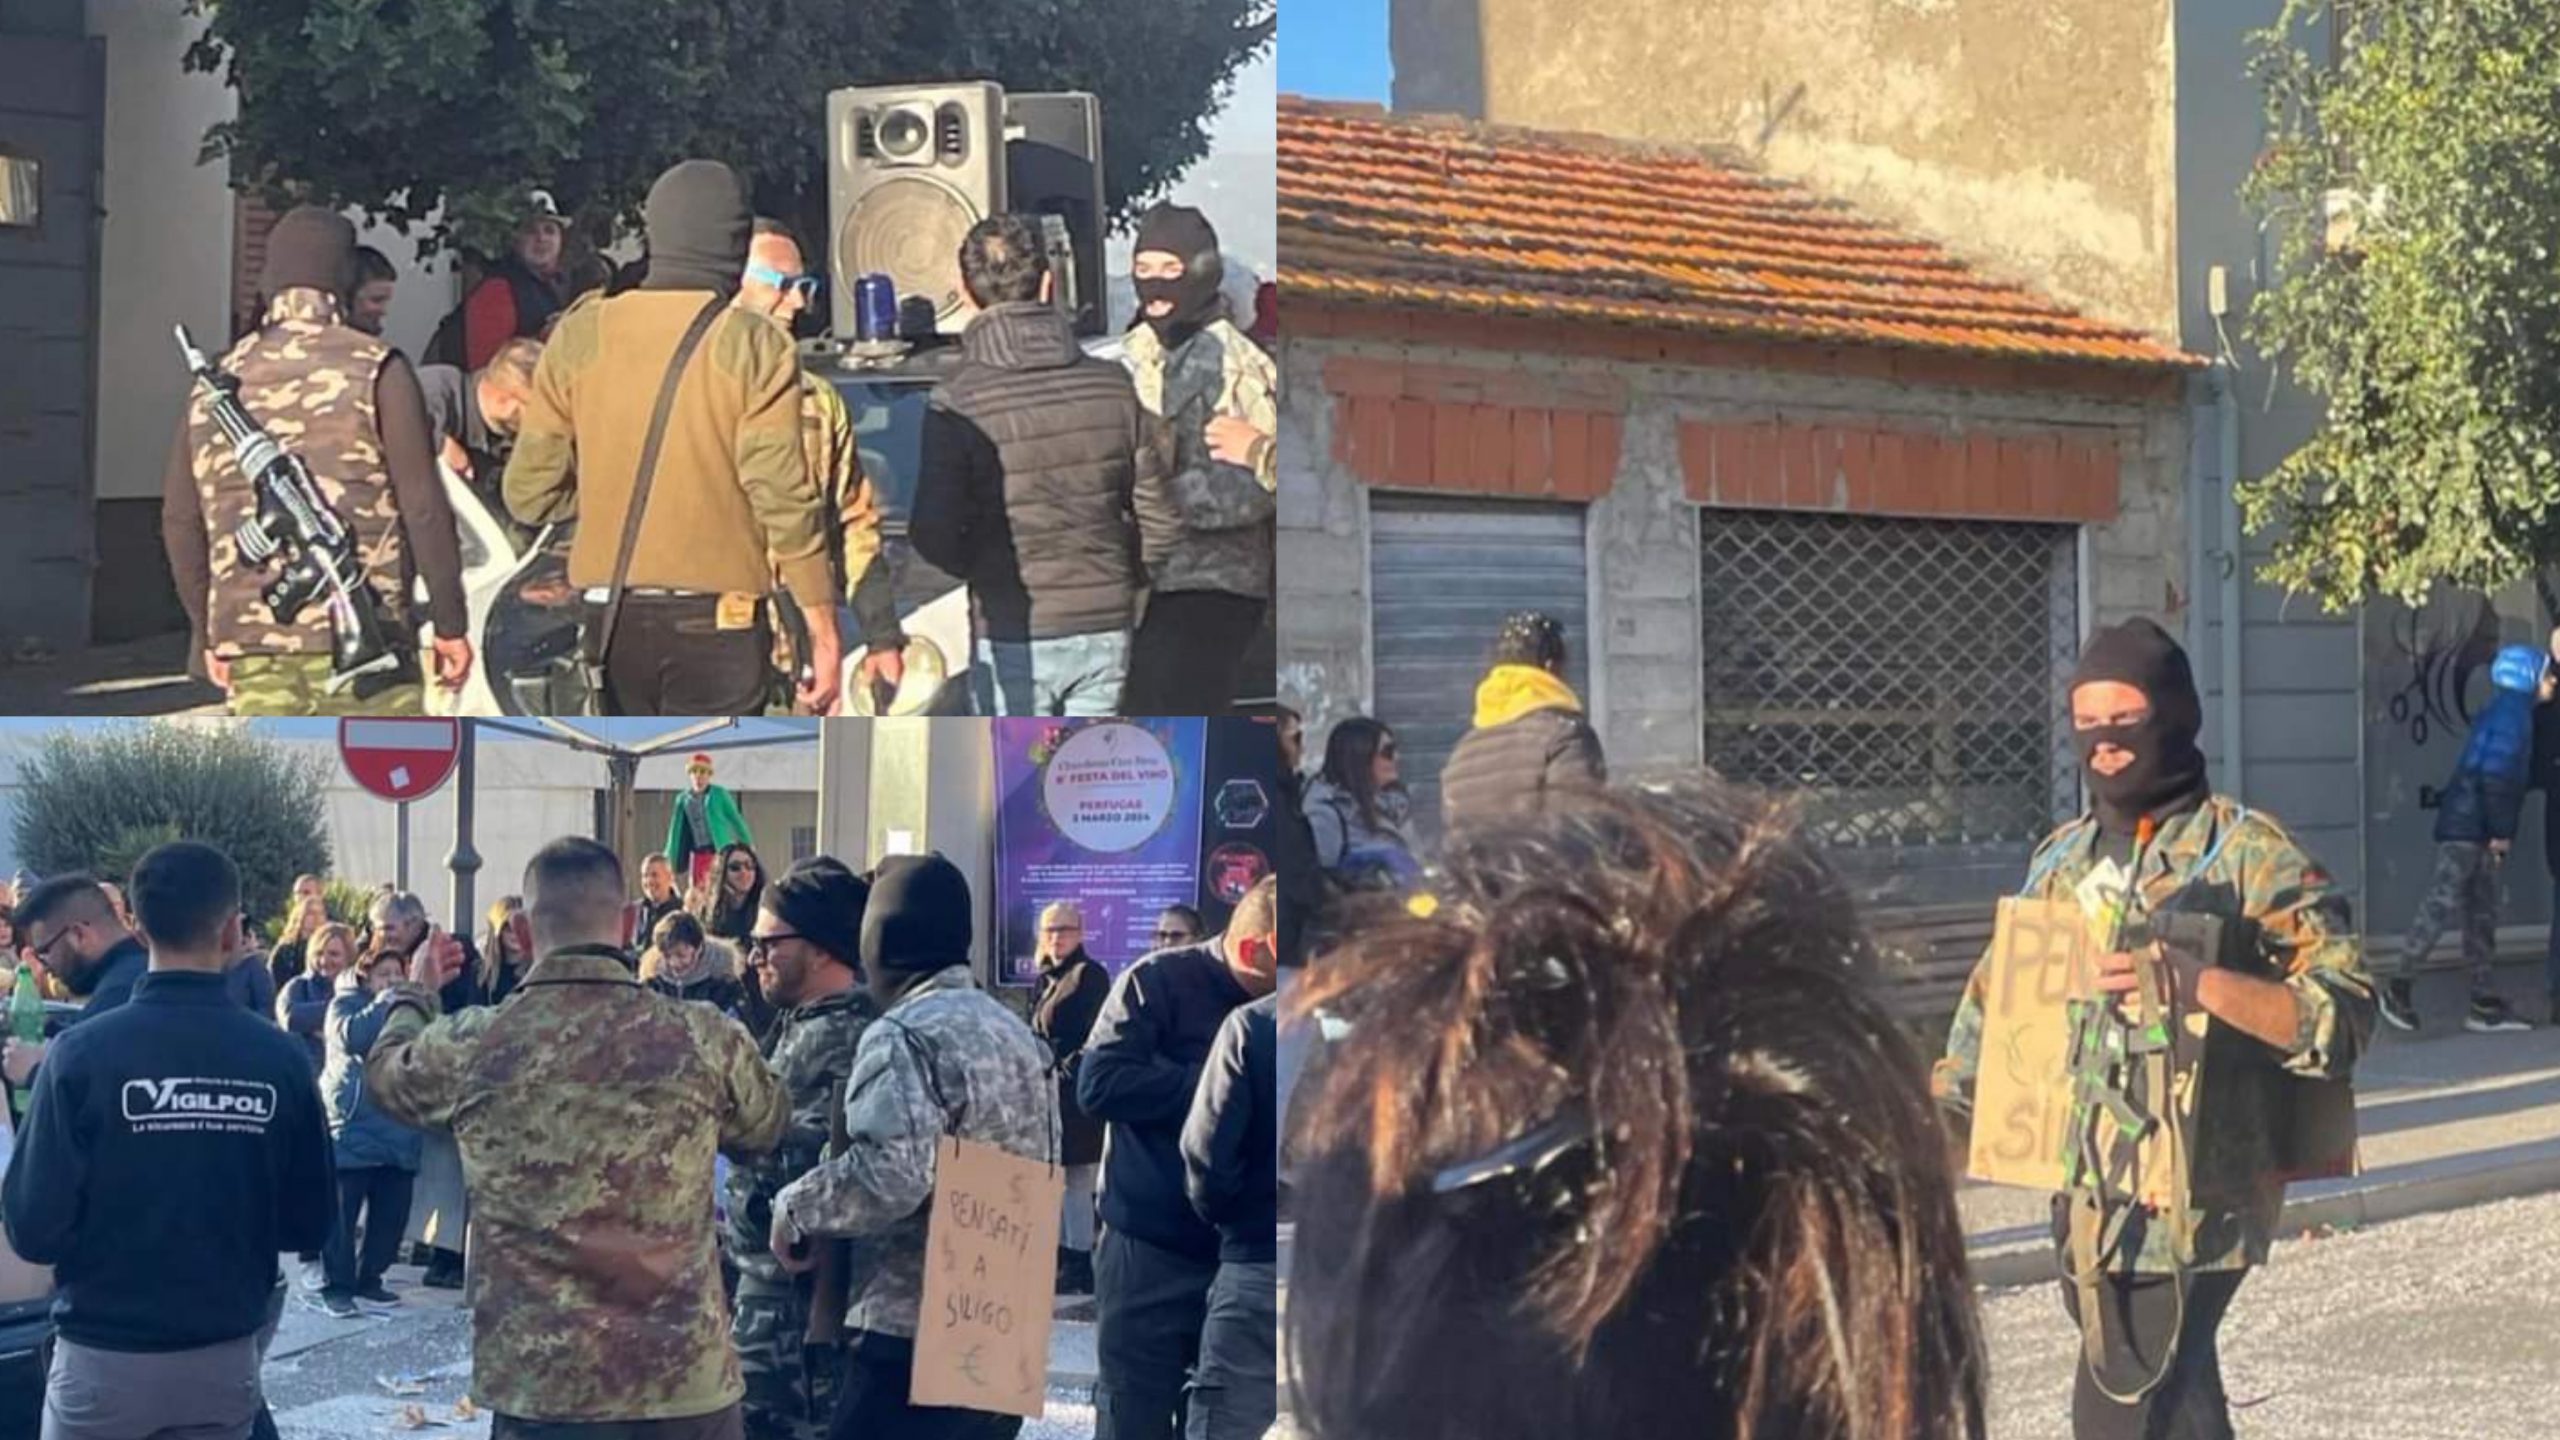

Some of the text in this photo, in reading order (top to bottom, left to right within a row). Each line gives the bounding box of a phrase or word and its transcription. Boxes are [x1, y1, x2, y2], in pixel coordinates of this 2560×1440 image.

[1070, 771, 1108, 783] FESTA
[1111, 770, 1133, 781] DEL
[1137, 769, 1168, 779] VINO
[1080, 799, 1142, 810] PERFUGAS
[1081, 812, 1121, 823] MARZO
[140, 1077, 268, 1115] VIGILPOL
[950, 1189, 1033, 1253] PENSATI
[973, 1253, 987, 1280] A
[946, 1289, 1016, 1335] SILIGO
